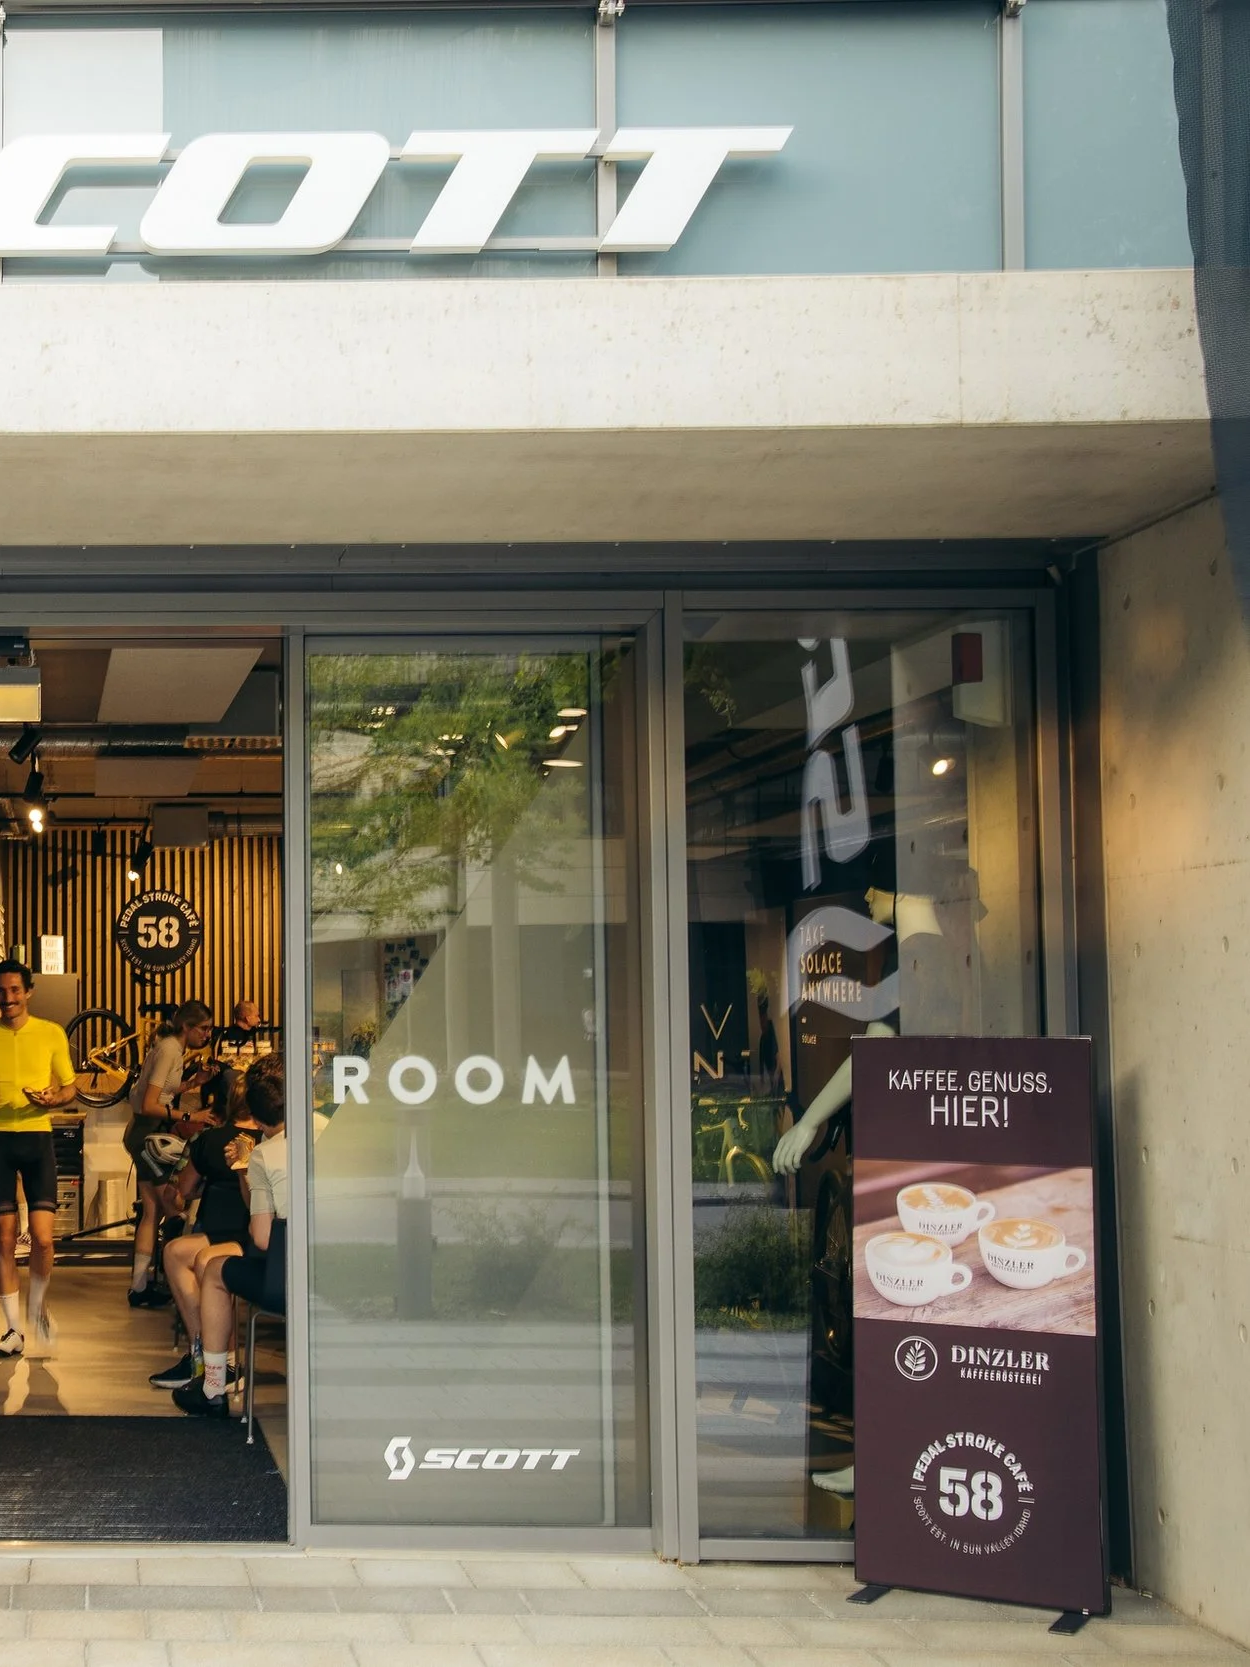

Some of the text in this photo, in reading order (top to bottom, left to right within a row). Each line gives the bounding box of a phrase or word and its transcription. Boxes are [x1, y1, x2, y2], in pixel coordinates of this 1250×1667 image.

[120, 900, 143, 928] PEDAL
[142, 892, 182, 907] STROKE
[137, 916, 180, 949] 58
[800, 925, 825, 946] TAKE
[800, 952, 842, 974] SOLACE
[801, 981, 862, 1002] ANYWHERE
[333, 1054, 576, 1105] ROOM
[889, 1069, 1052, 1094] KAFFEE. GENUSS.
[930, 1095, 1009, 1128] HIER!
[918, 1221, 963, 1231] DINZLER
[987, 1252, 1034, 1271] DINZLER
[875, 1271, 924, 1288] DINZLER
[950, 1344, 1050, 1371] DINZLER
[419, 1447, 581, 1471] SCOTT
[912, 1431, 1034, 1492] PEDAL STROKE CAFÉ
[938, 1466, 1003, 1521] 58
[913, 1496, 932, 1527] SCOTT
[949, 1538, 961, 1551] IN
[962, 1543, 982, 1555] SUN
[984, 1534, 1016, 1555] VALLEY
[1013, 1508, 1032, 1538] IDAHO
